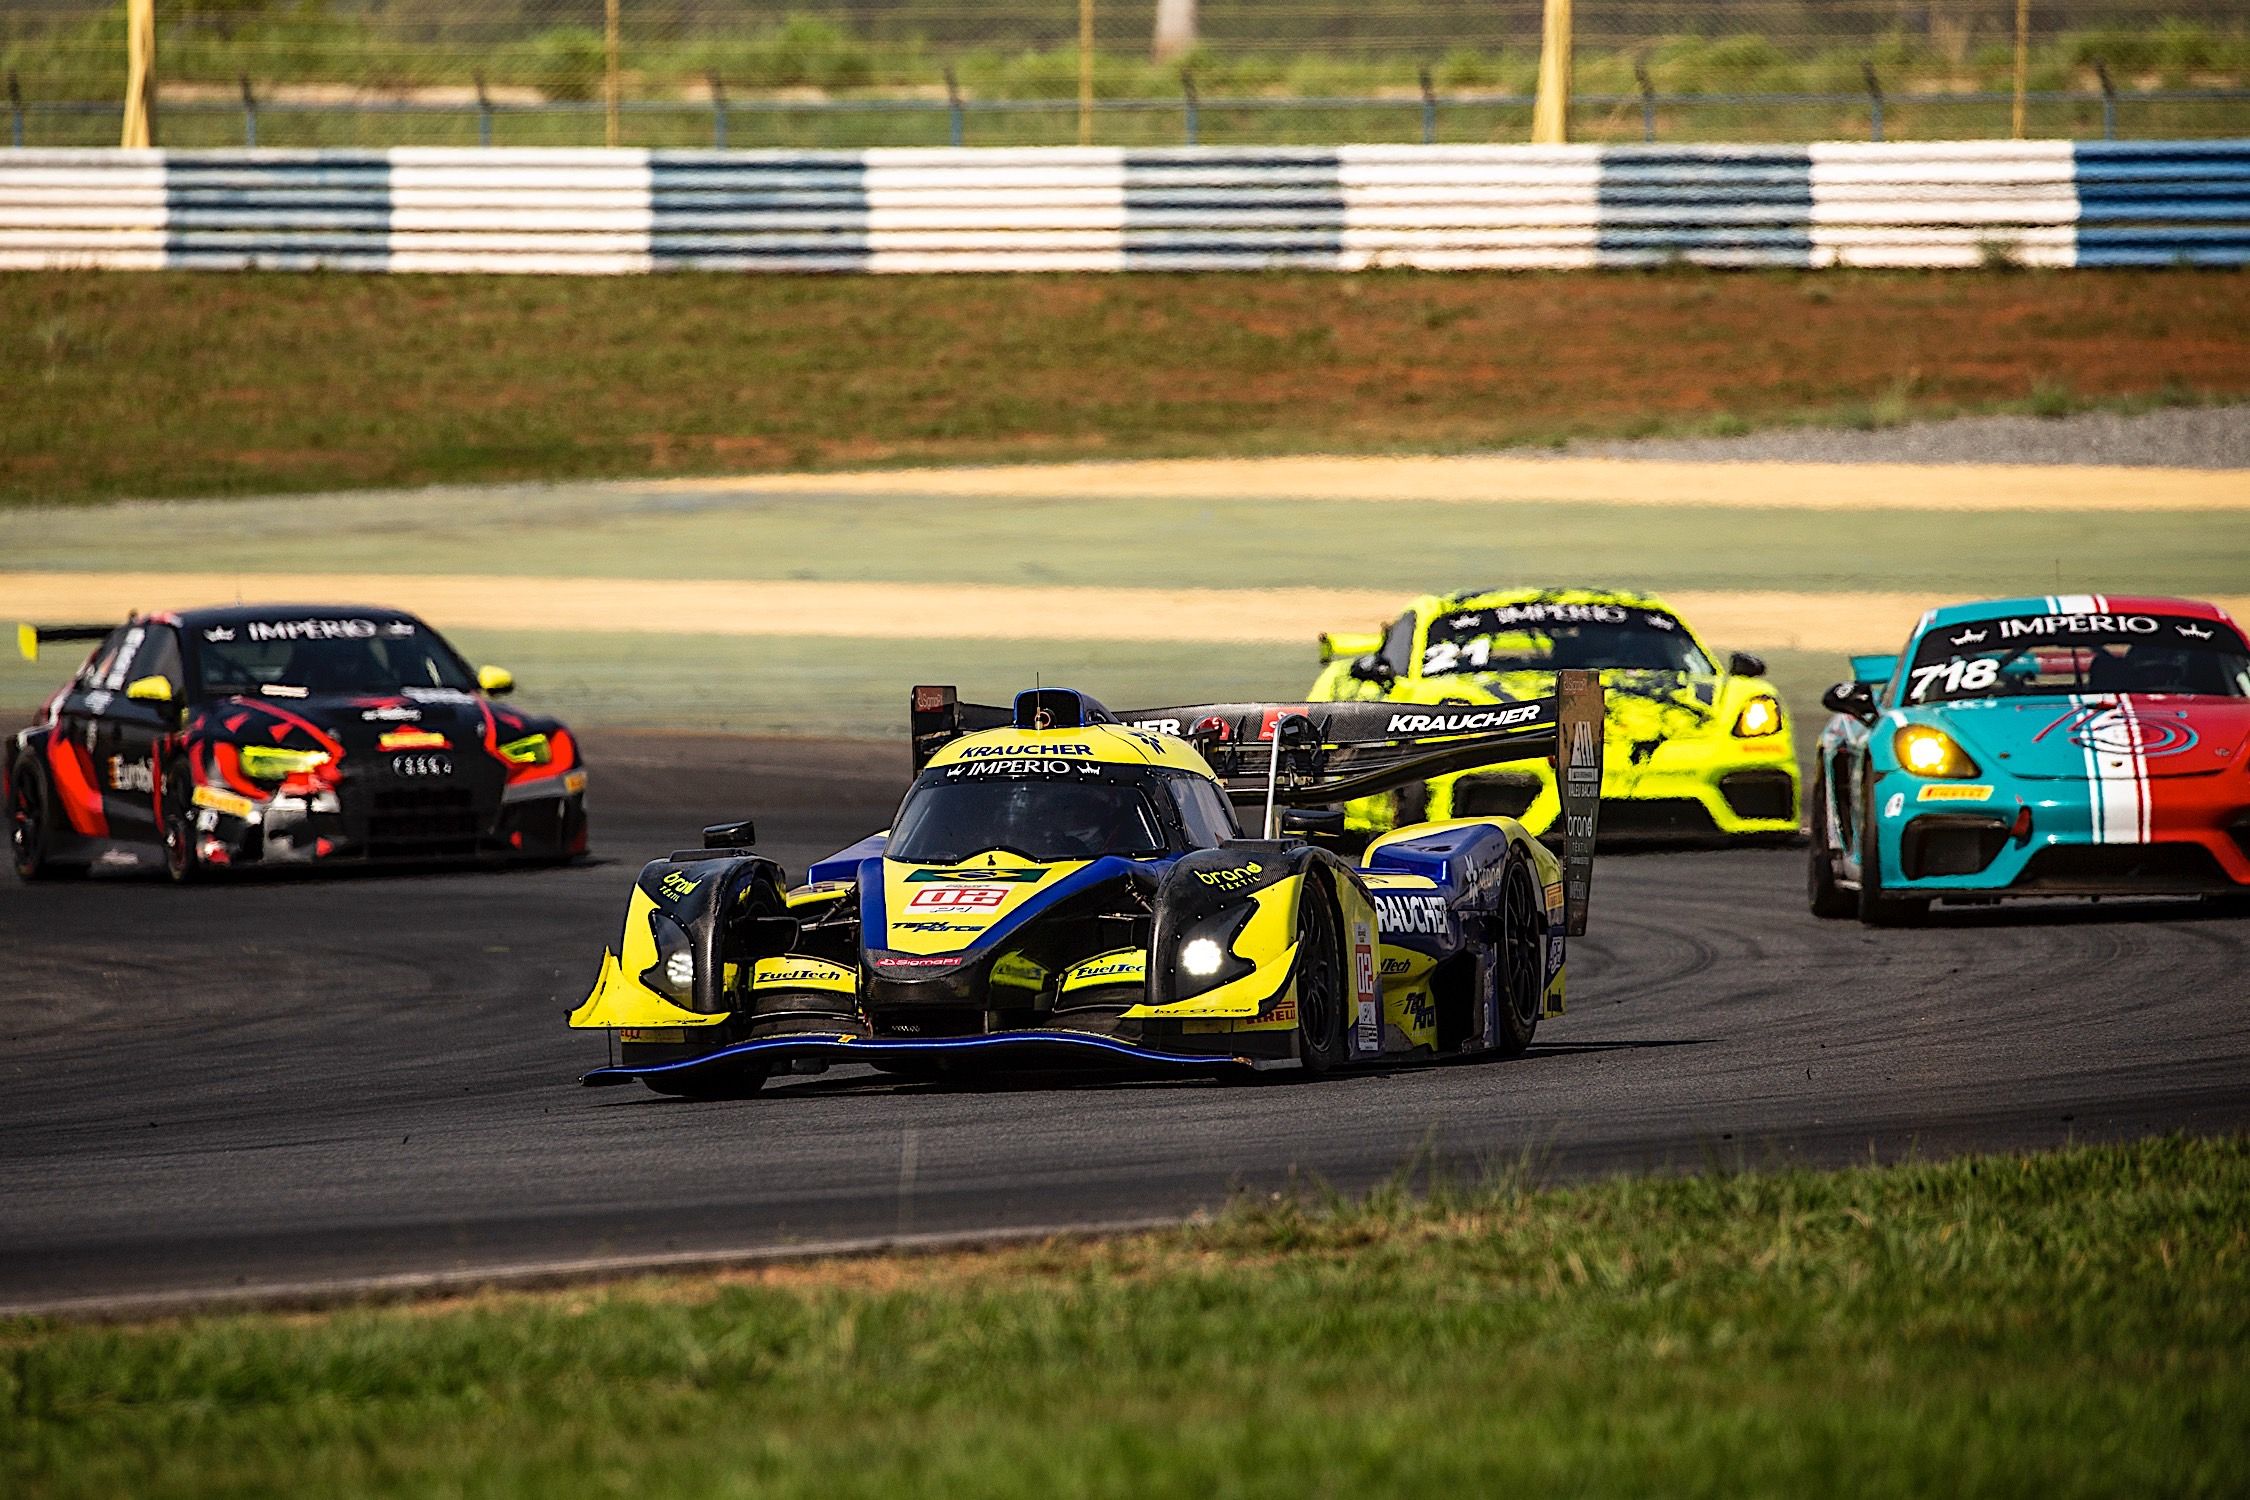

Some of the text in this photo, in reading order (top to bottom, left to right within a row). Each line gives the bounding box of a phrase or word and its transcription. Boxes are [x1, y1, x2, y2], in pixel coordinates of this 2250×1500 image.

[1421, 633, 1491, 677] 21
[1910, 657, 2000, 700] 718
[1387, 704, 1541, 732] KRAUCHER
[960, 744, 1094, 758] KRAUCHER
[1194, 861, 1263, 885] brand
[912, 890, 1007, 905] 02
[1374, 895, 1450, 934] RAUCHER
[757, 970, 841, 983] FuelTech
[1075, 964, 1145, 979] FuelTec
[1356, 952, 1374, 994] 02
